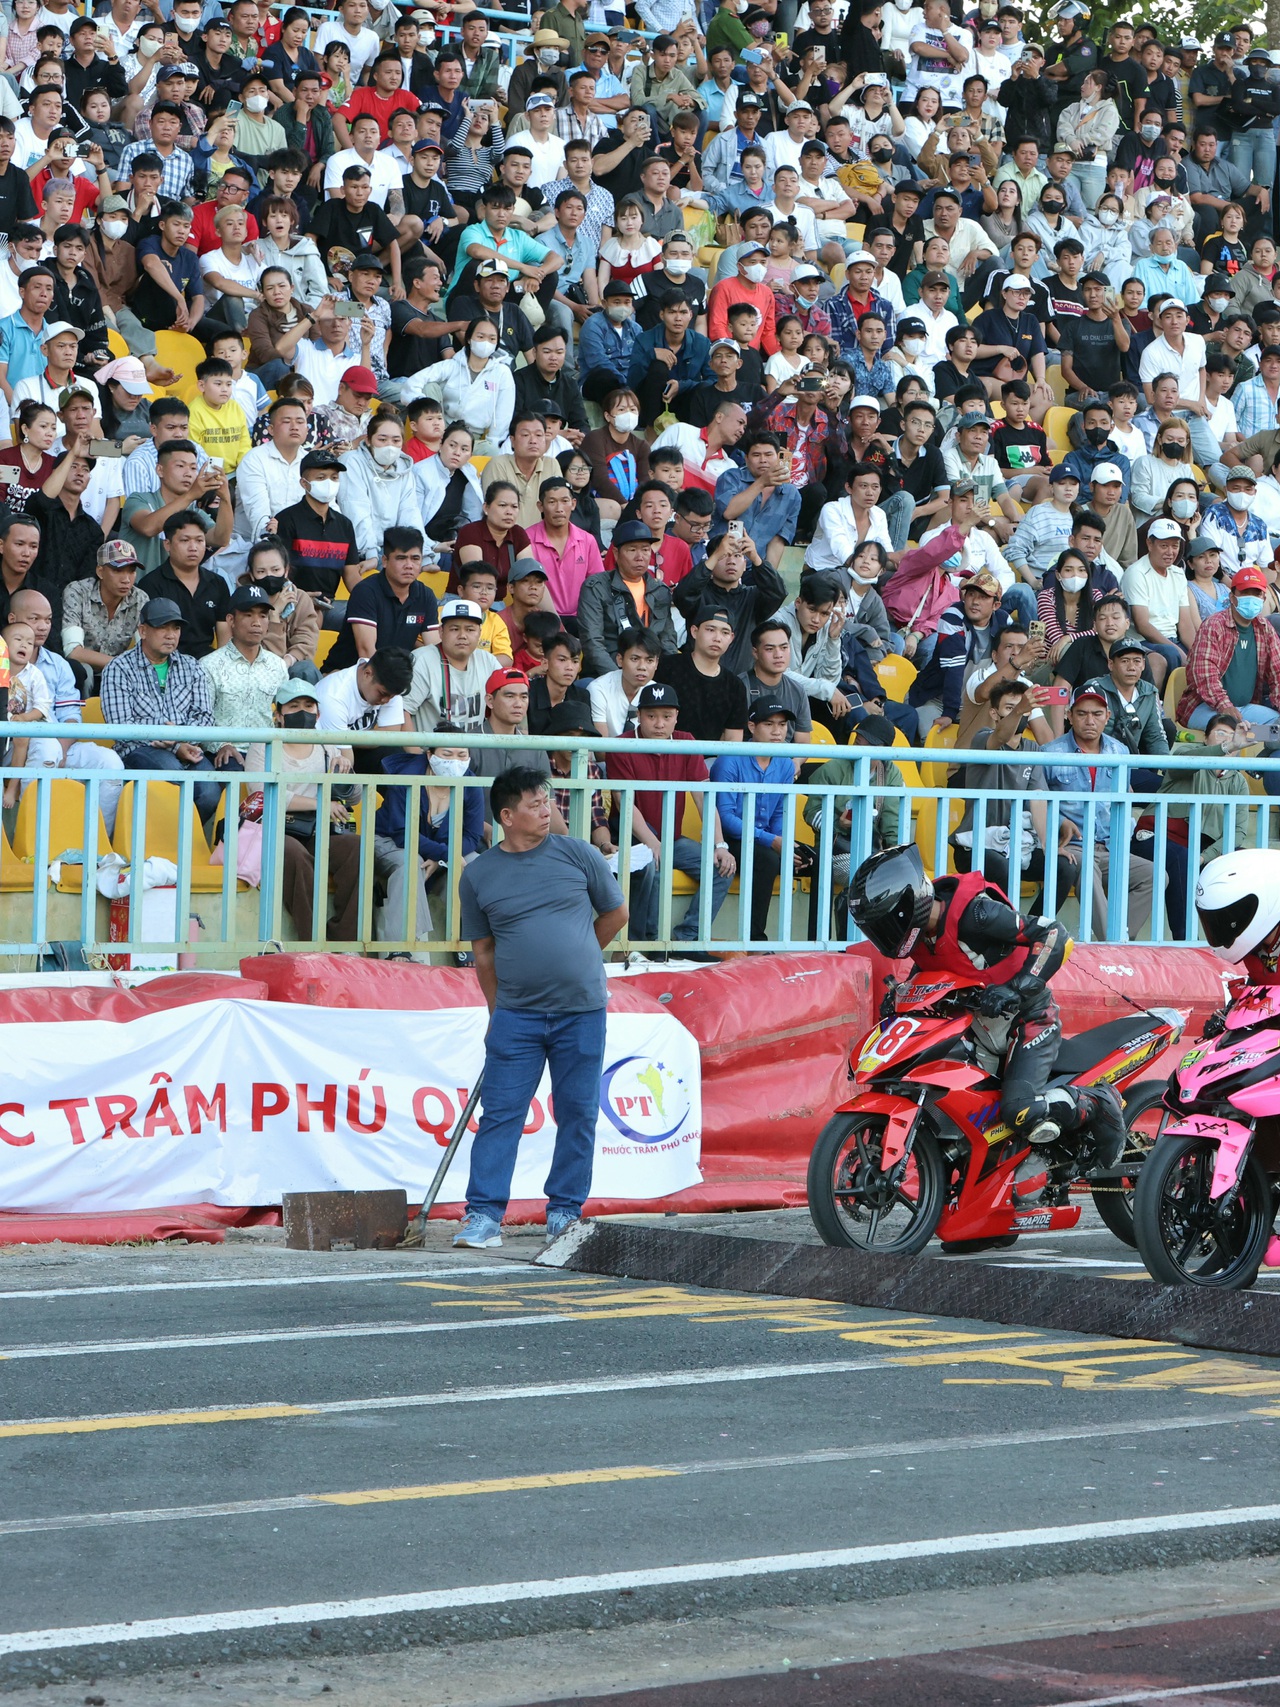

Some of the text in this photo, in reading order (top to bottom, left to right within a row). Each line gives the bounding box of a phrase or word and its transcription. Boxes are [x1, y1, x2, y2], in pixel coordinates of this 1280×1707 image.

[49, 1072, 227, 1146] TRÂM
[252, 1068, 387, 1134] PHÚ
[412, 1086, 558, 1148] QU
[614, 1096, 652, 1117] PT
[602, 1130, 701, 1155] PHƯỚC TRÂM PHÚ QUỐ
[1015, 1213, 1053, 1225] RAPIDE
